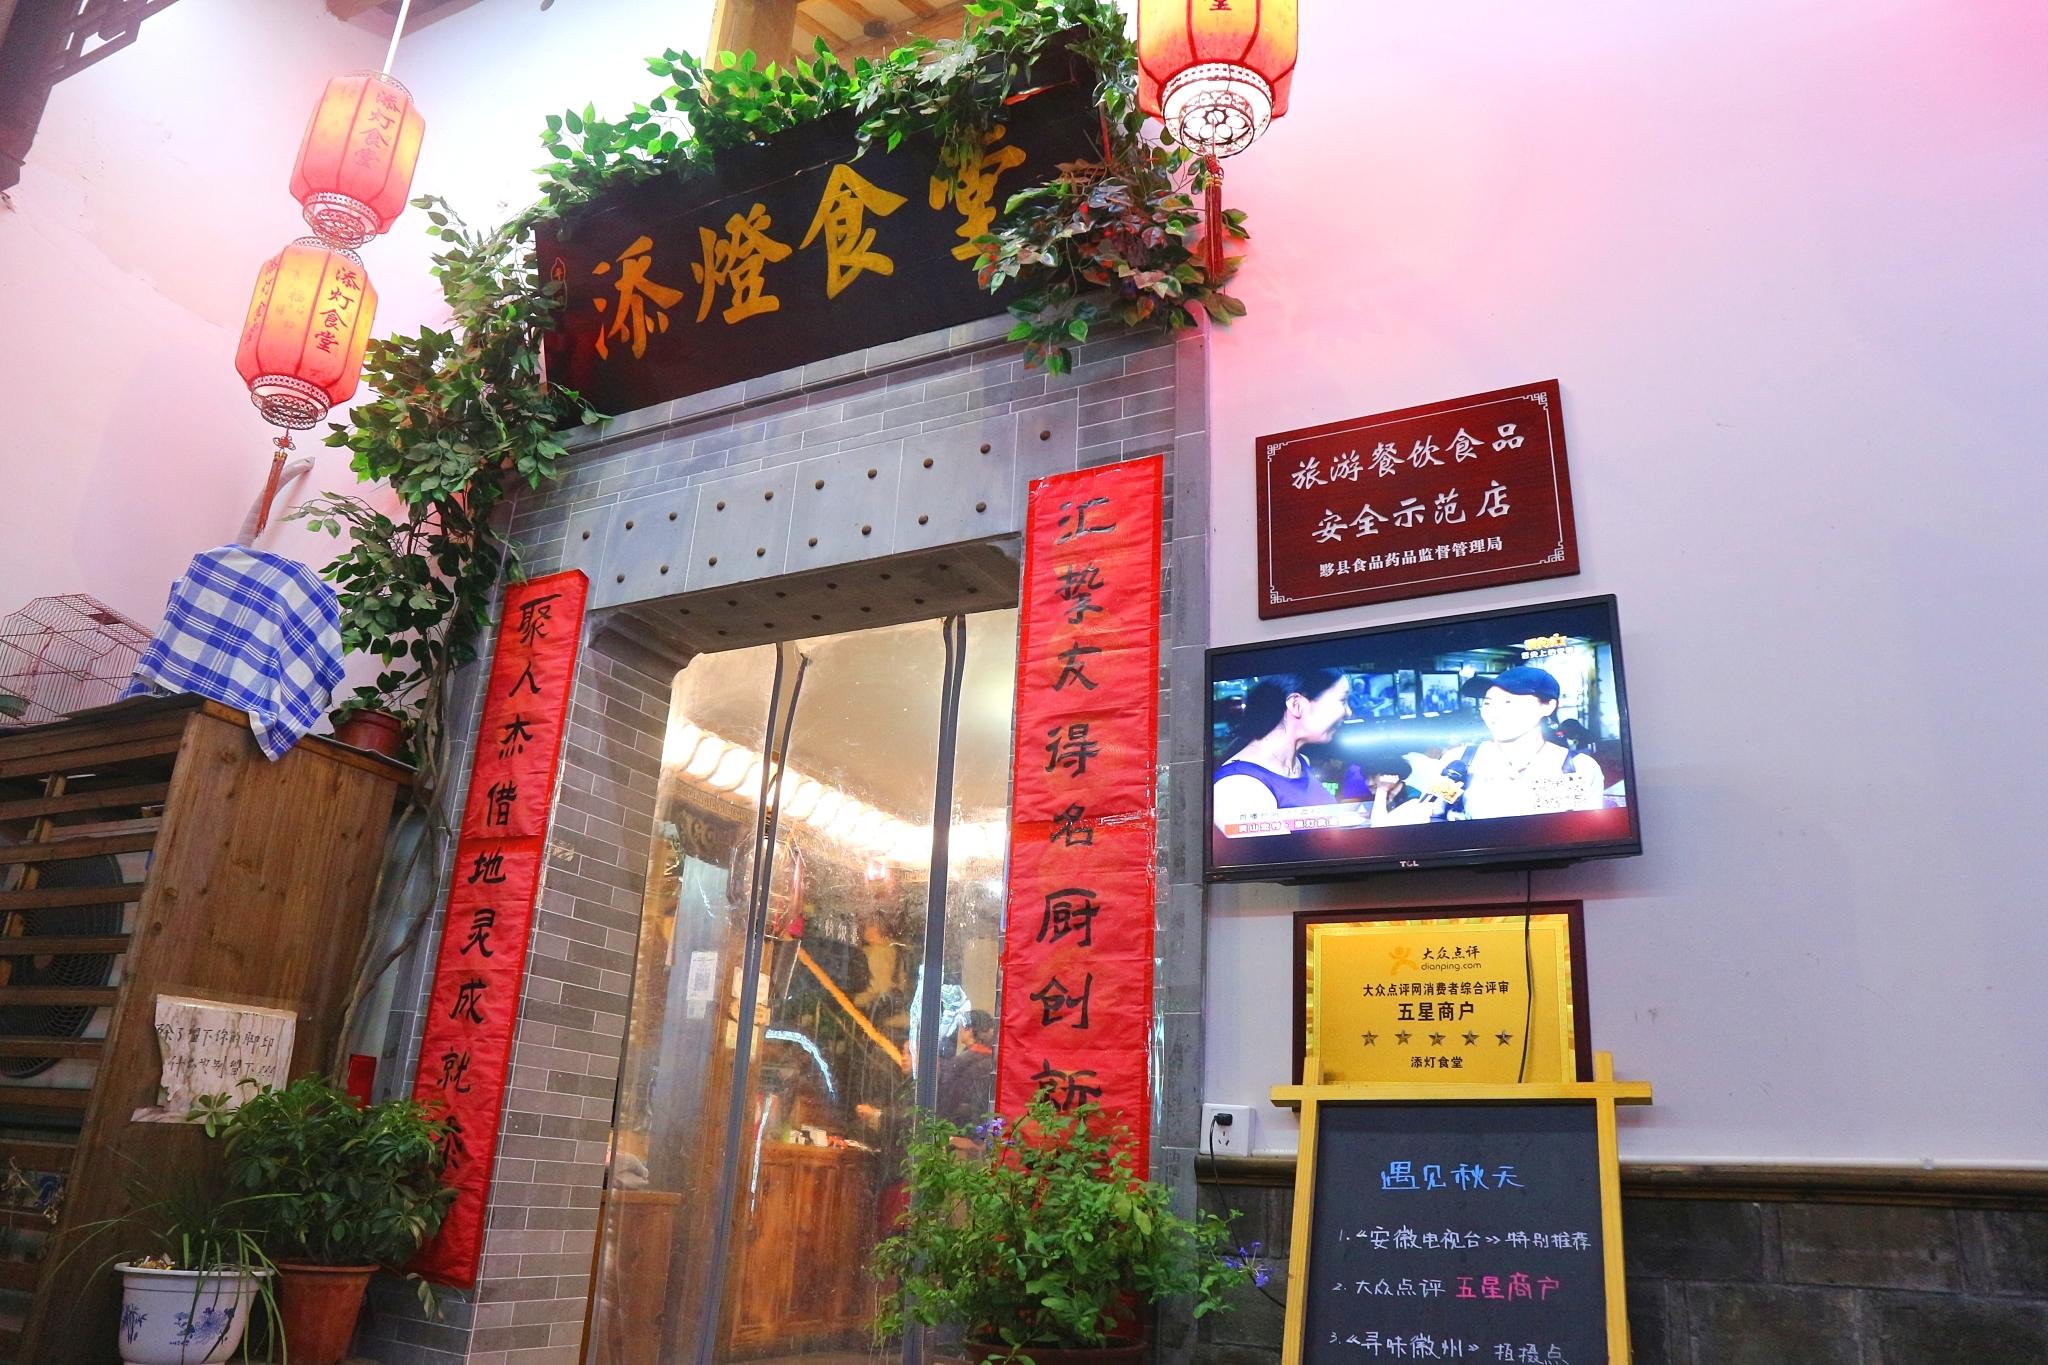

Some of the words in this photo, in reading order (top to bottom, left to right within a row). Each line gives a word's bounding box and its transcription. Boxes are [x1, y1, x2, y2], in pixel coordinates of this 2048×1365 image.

[314, 266, 360, 354] 添灯食堂
[1291, 422, 1526, 490] 旅游餐饮食品
[1311, 479, 1511, 544] 安全示范店
[1319, 536, 1503, 578] 黟县食品药品监督管理局
[1421, 945, 1480, 960] 大众点评
[1421, 961, 1482, 972] dianping.com
[1363, 981, 1509, 997] 大众点评网消费者综合评审
[1397, 1001, 1474, 1021] 五星商户
[1410, 1056, 1463, 1069] 添灯食堂
[1380, 1160, 1525, 1190] 遇见秋天
[1455, 1271, 1560, 1301] 五星商户
